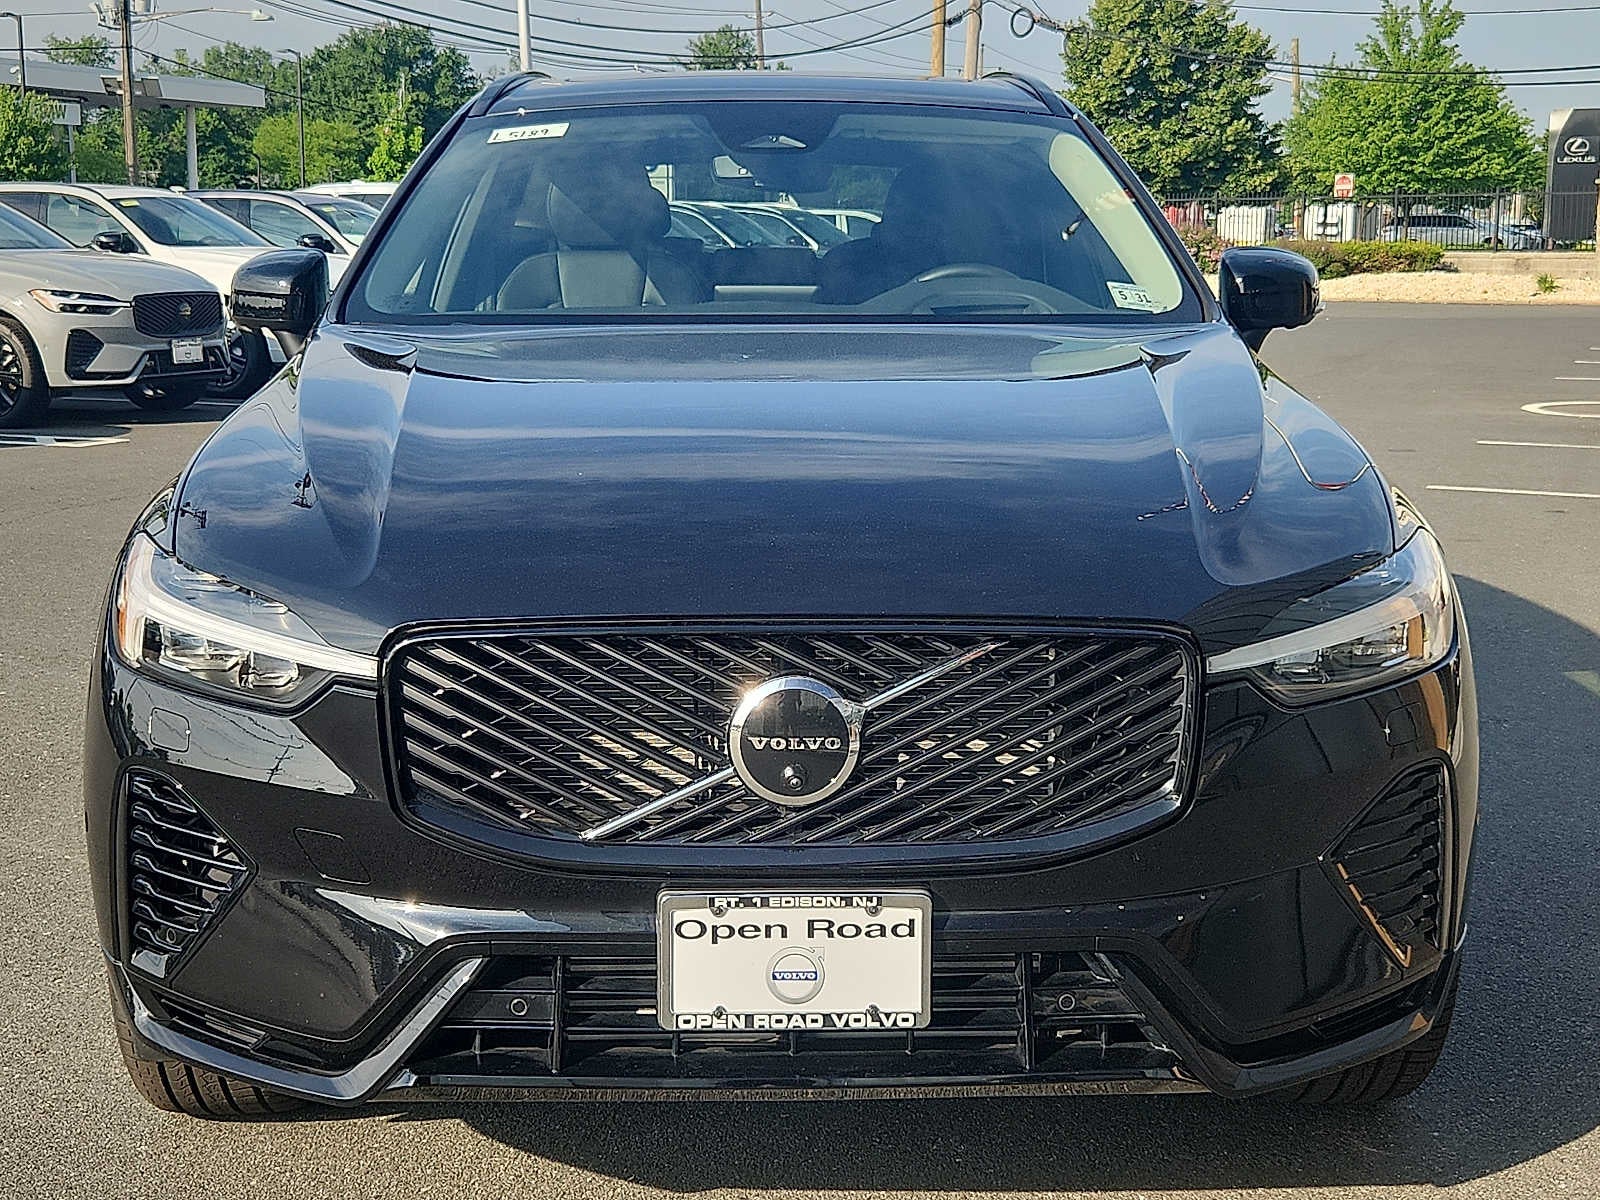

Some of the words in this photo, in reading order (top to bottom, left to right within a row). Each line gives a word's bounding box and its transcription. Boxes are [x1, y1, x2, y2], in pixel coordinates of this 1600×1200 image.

[748, 737, 841, 750] VOLVO
[713, 897, 744, 908] RT.
[752, 897, 761, 908] 1
[852, 896, 878, 908] NJ
[675, 919, 787, 944] Open
[807, 918, 915, 939] Road
[775, 971, 816, 980] VOLVO
[677, 1014, 745, 1029] OPEN
[753, 1014, 824, 1029] ROAD
[830, 1014, 915, 1029] VOLVO
